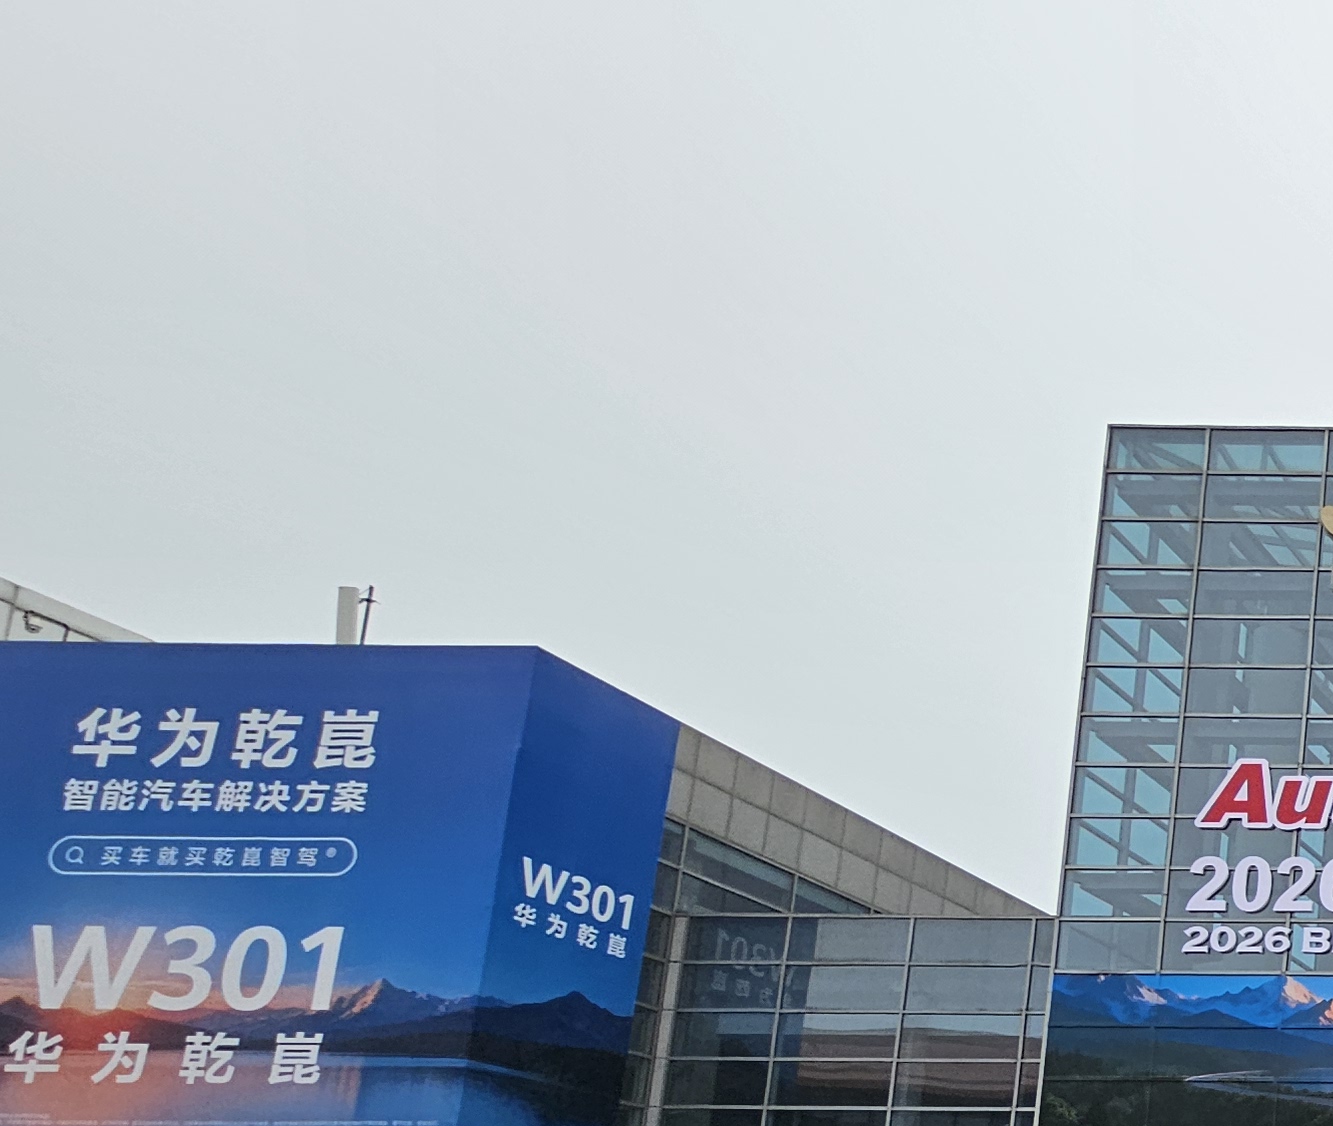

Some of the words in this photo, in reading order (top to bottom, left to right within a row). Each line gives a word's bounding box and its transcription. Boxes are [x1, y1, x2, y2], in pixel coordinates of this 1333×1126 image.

[72, 707, 379, 769] 华为乾崑
[62, 779, 368, 814] 智能汽车解决方案
[521, 855, 635, 930] W301
[512, 902, 627, 959] 华为乾崑
[1181, 927, 1292, 956] 2026
[31, 923, 346, 1013] W301
[4, 1030, 325, 1085] 华为乾崑
